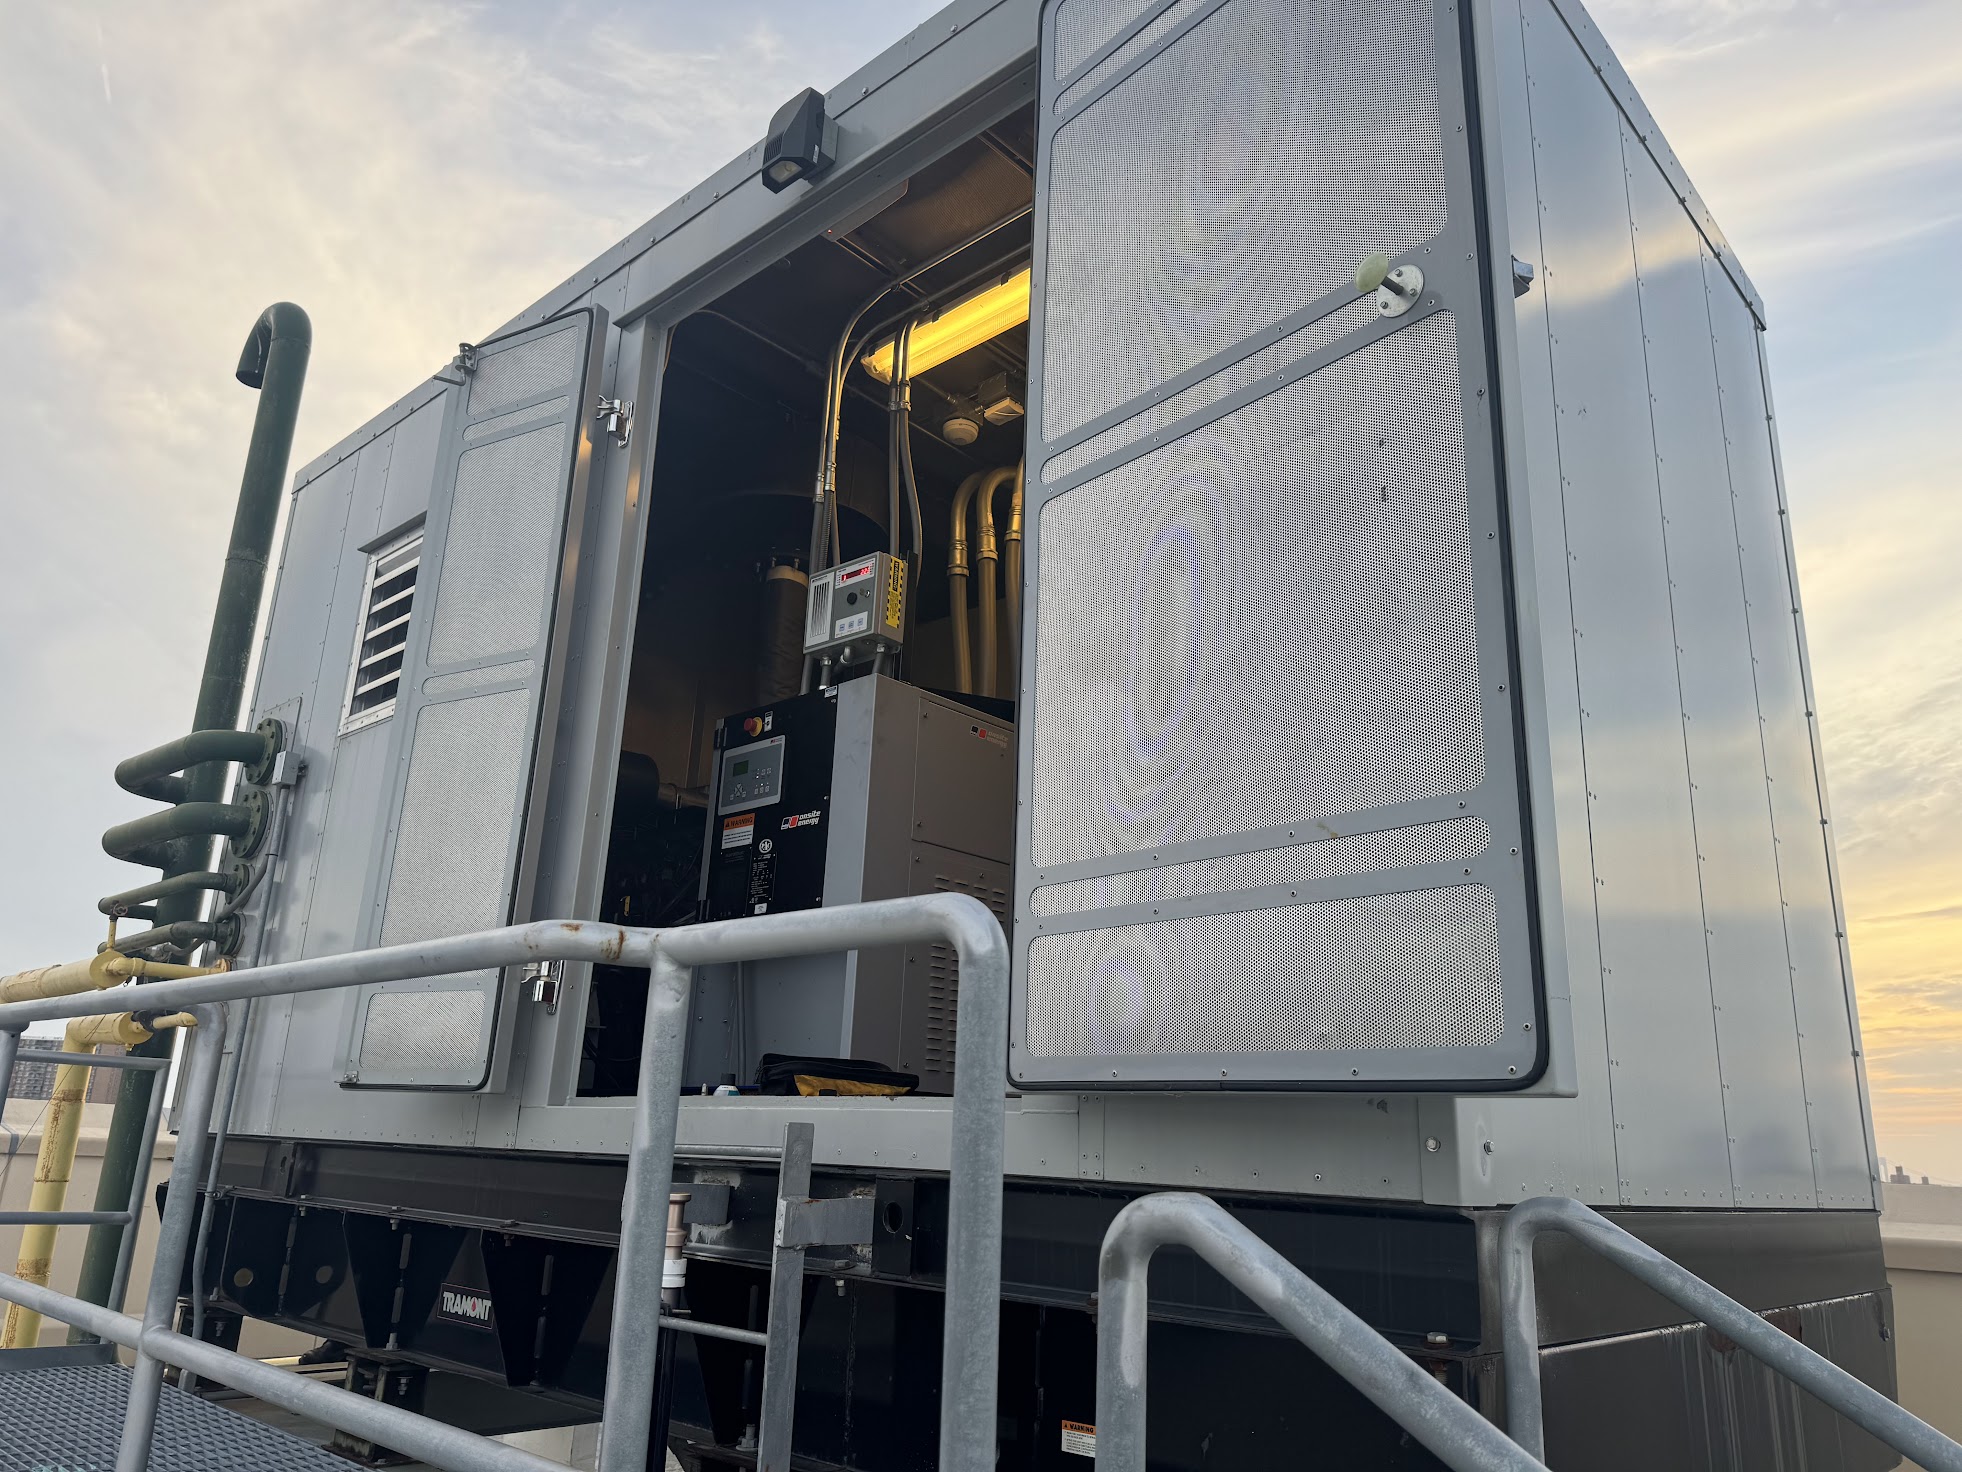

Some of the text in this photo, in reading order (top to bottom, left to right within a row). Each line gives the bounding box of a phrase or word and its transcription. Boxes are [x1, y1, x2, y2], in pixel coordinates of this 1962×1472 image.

[799, 810, 821, 820] onsite
[730, 816, 753, 827] WARNING
[797, 817, 820, 826] energy
[443, 1292, 491, 1320] TRAMONT
[1070, 1424, 1093, 1433] WARNING
